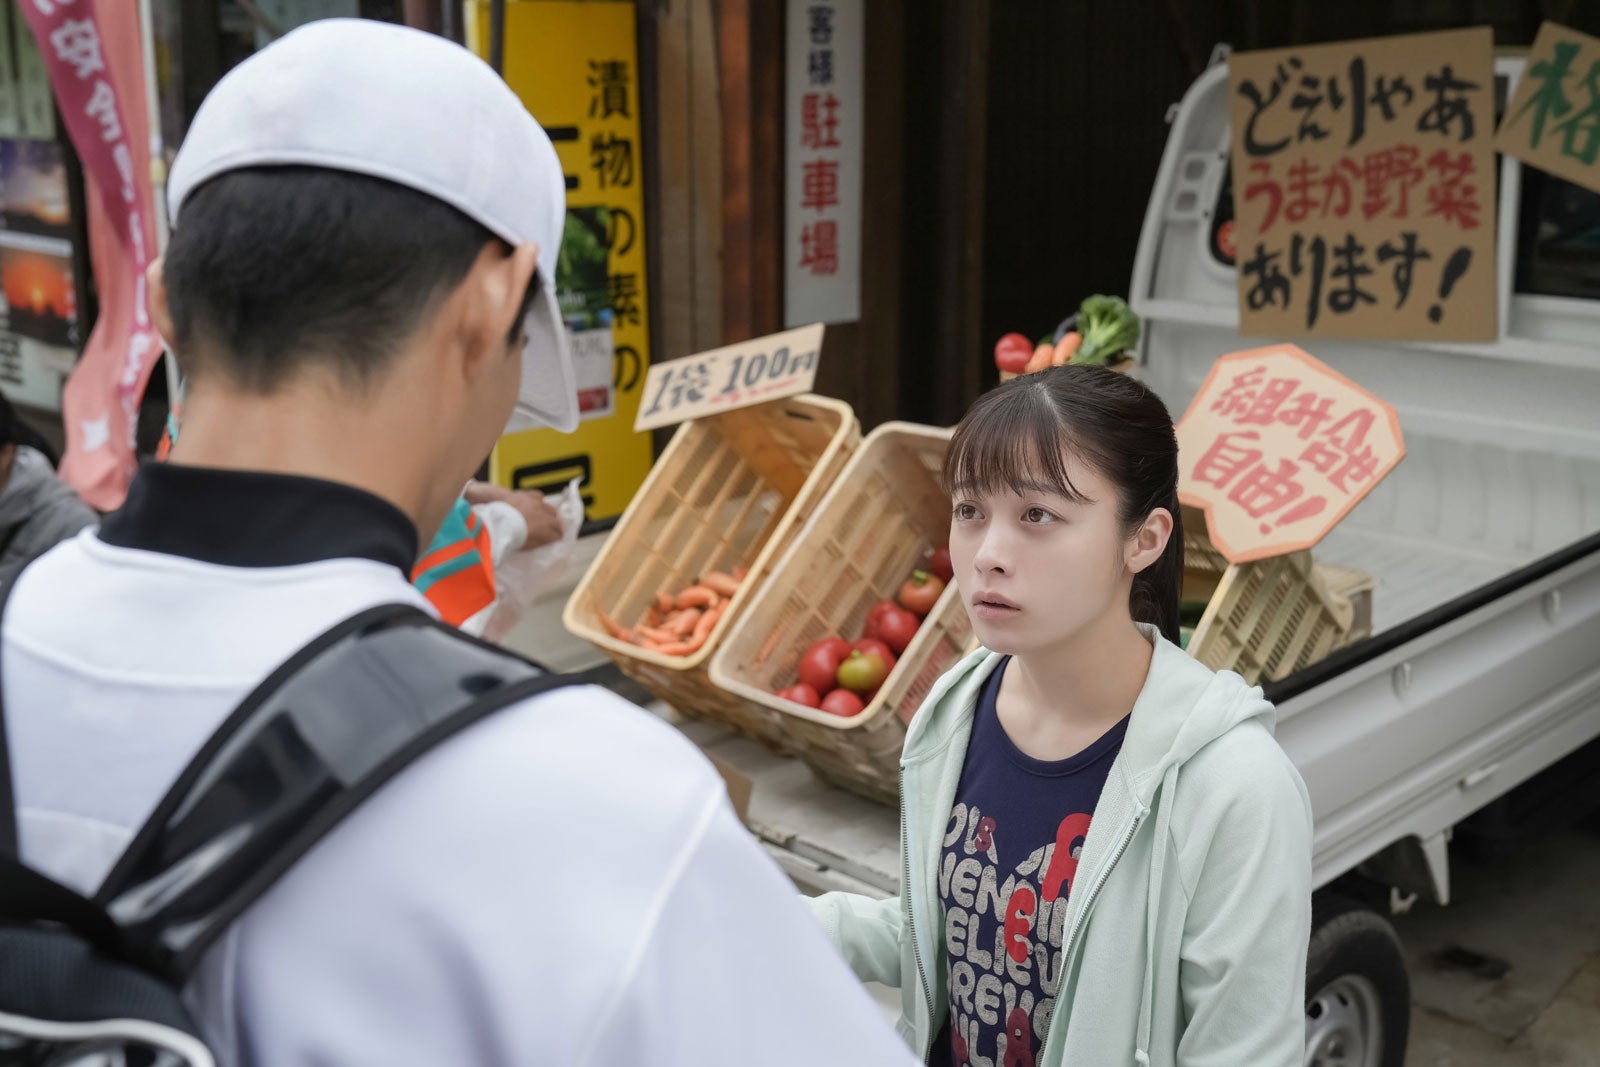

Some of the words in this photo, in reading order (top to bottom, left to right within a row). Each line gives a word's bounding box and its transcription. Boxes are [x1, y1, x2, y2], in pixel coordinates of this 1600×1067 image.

[1243, 143, 1482, 234] うまか野菜
[720, 346, 819, 394] 100円
[1191, 430, 1328, 536] 自由!
